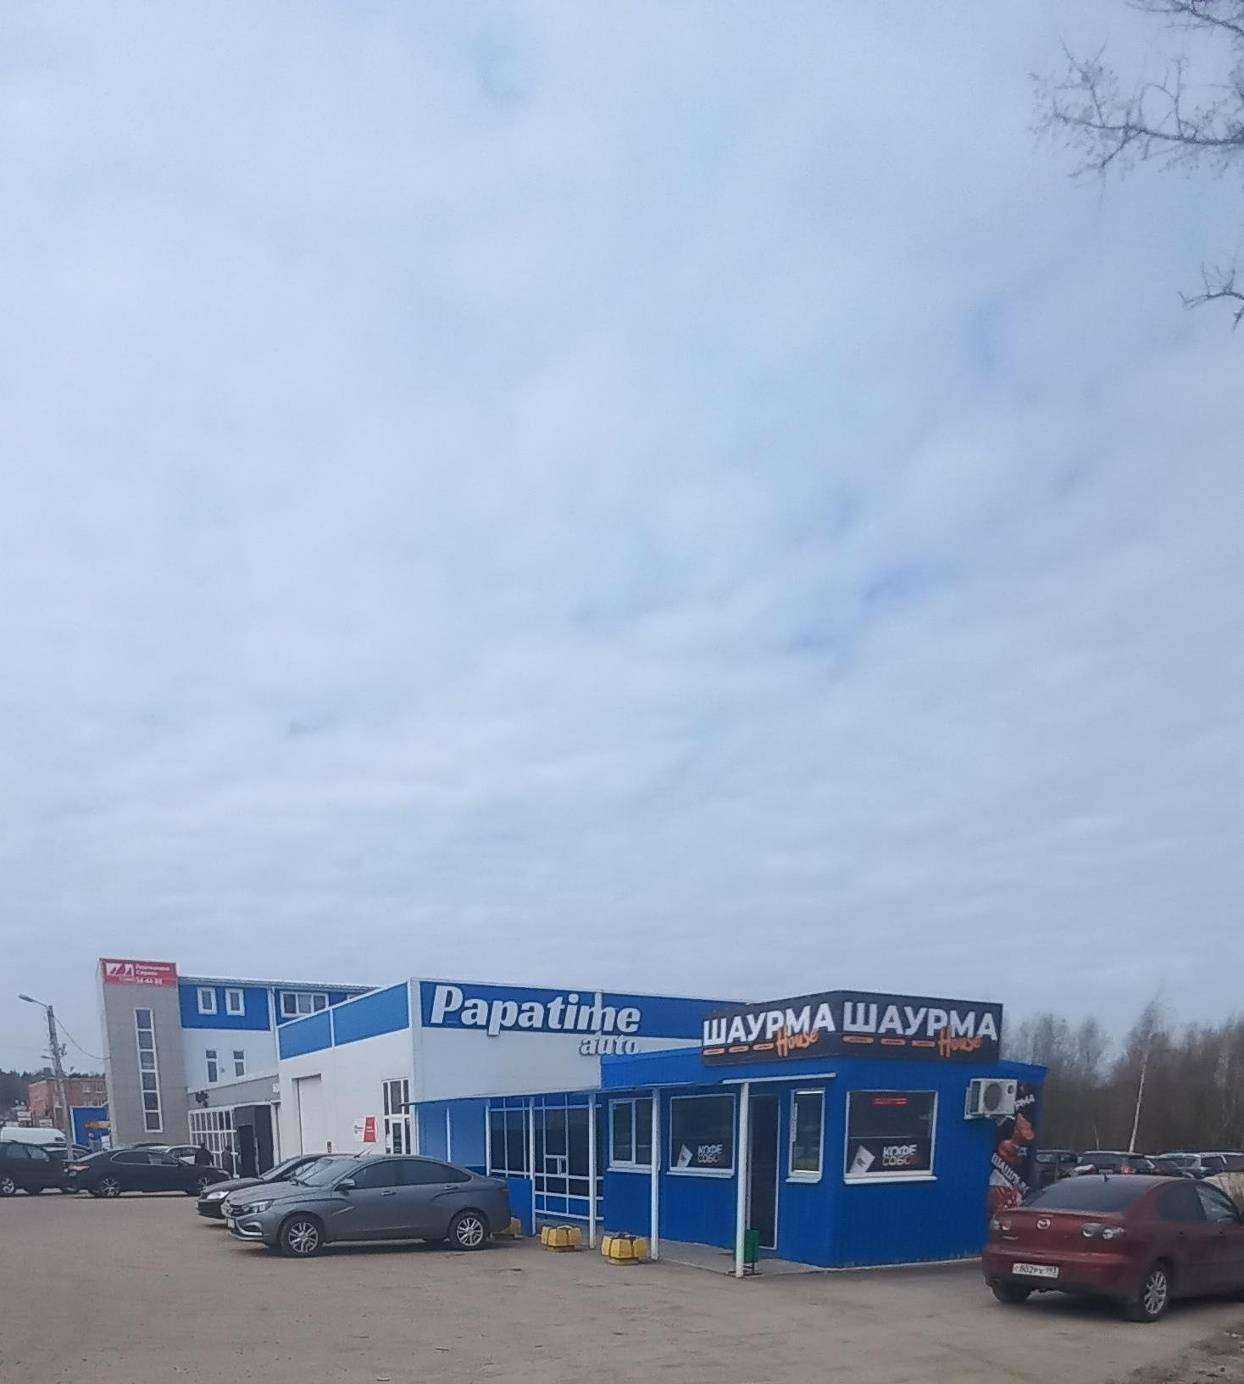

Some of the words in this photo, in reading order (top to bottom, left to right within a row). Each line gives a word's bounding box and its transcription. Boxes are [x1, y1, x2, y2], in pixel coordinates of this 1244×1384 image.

[430, 985, 641, 1036] Papatime
[703, 1003, 836, 1046] ШАУРМА
[843, 1002, 998, 1041] ШАУРМА
[578, 1033, 639, 1056] auto
